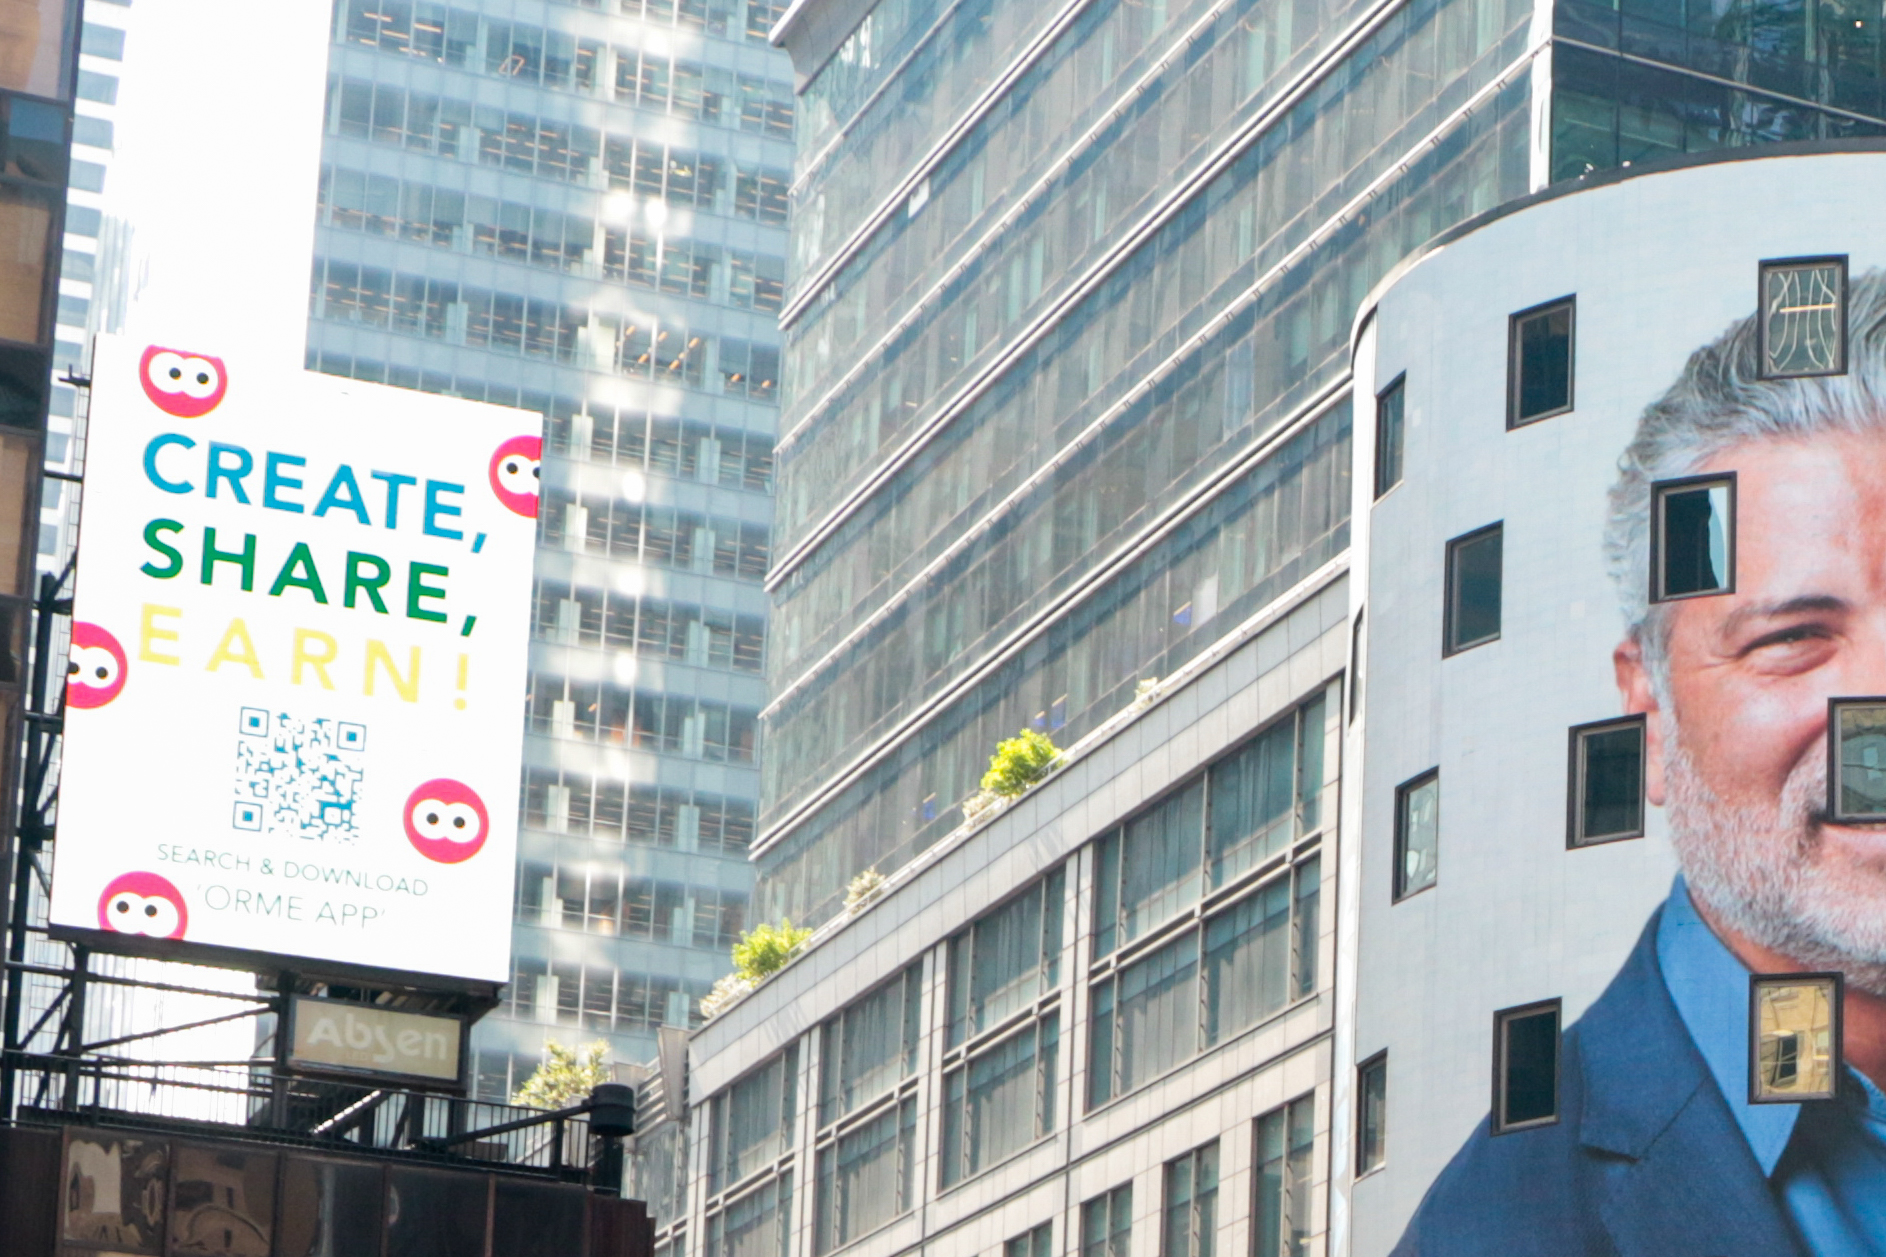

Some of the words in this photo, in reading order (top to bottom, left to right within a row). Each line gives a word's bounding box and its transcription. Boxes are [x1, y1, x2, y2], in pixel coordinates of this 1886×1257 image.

[143, 433, 487, 553] CREATE,
[139, 518, 477, 637] SHARE,
[138, 602, 468, 710] EARN!
[157, 843, 251, 872] SEARCH
[260, 858, 274, 875] &
[284, 861, 428, 896] DOWNLOAD
[307, 1012, 448, 1063] Absen
